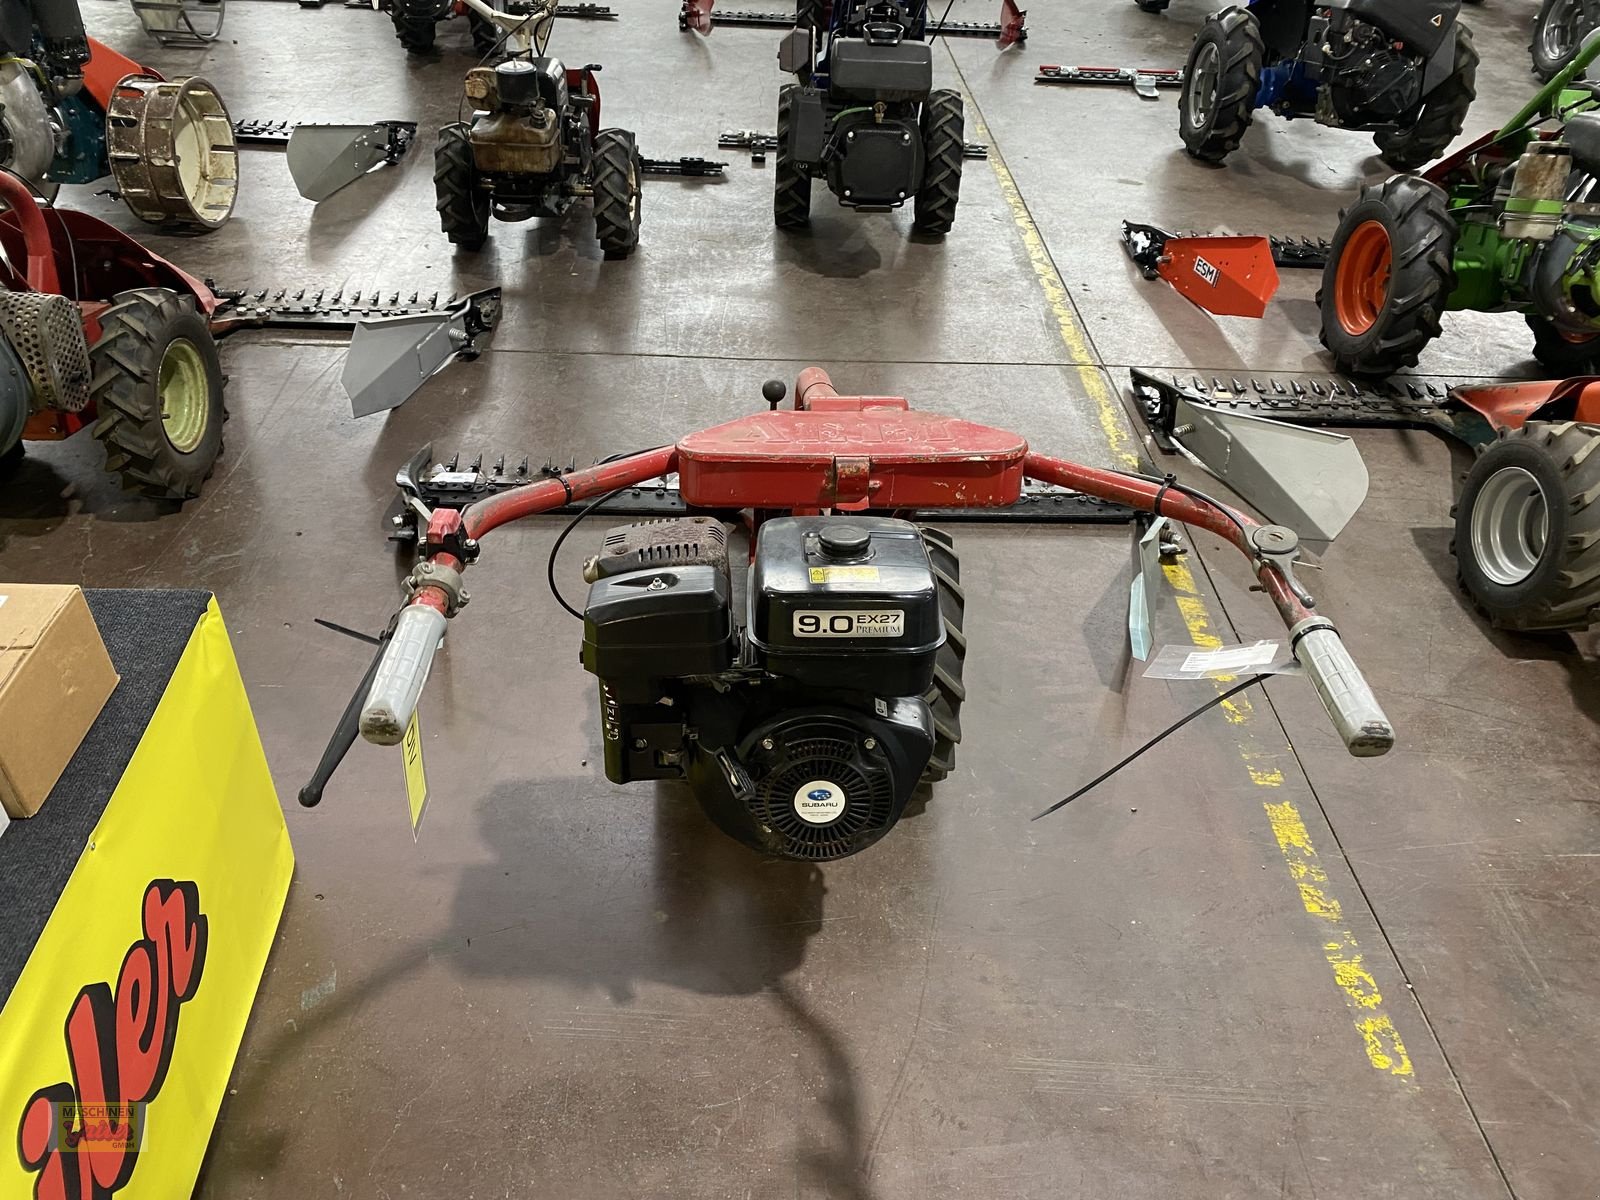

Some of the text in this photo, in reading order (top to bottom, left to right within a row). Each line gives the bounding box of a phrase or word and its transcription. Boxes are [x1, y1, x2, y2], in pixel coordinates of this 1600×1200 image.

[1196, 258, 1215, 282] ESM
[798, 614, 900, 634] 9.0 EX27
